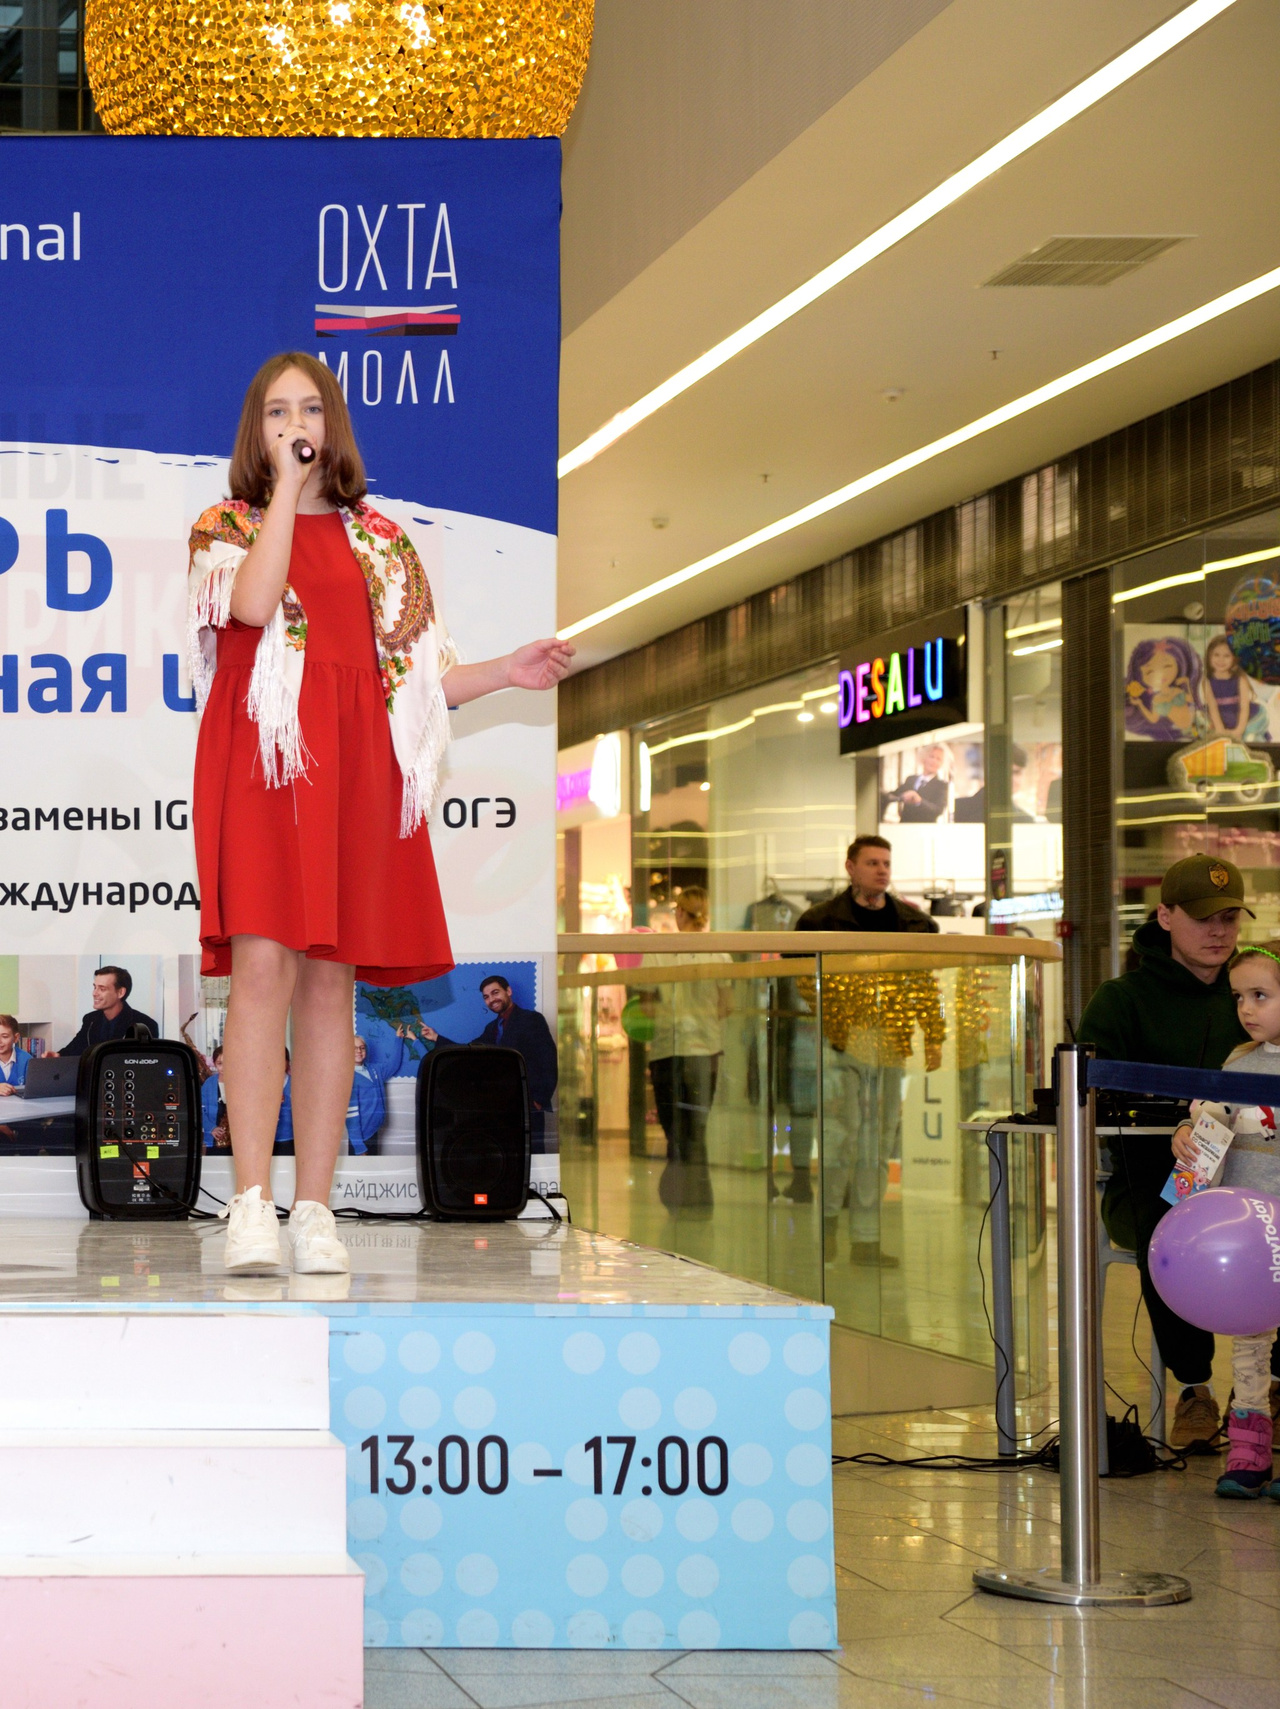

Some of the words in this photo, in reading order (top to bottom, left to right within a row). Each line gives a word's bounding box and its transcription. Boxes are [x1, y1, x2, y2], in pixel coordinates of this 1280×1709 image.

[318, 203, 458, 292] ОХТА
[838, 637, 943, 728] DESALU
[443, 797, 516, 828] ОГЭ
[361, 1434, 509, 1495] 13:00
[584, 1435, 729, 1496] 17:00
